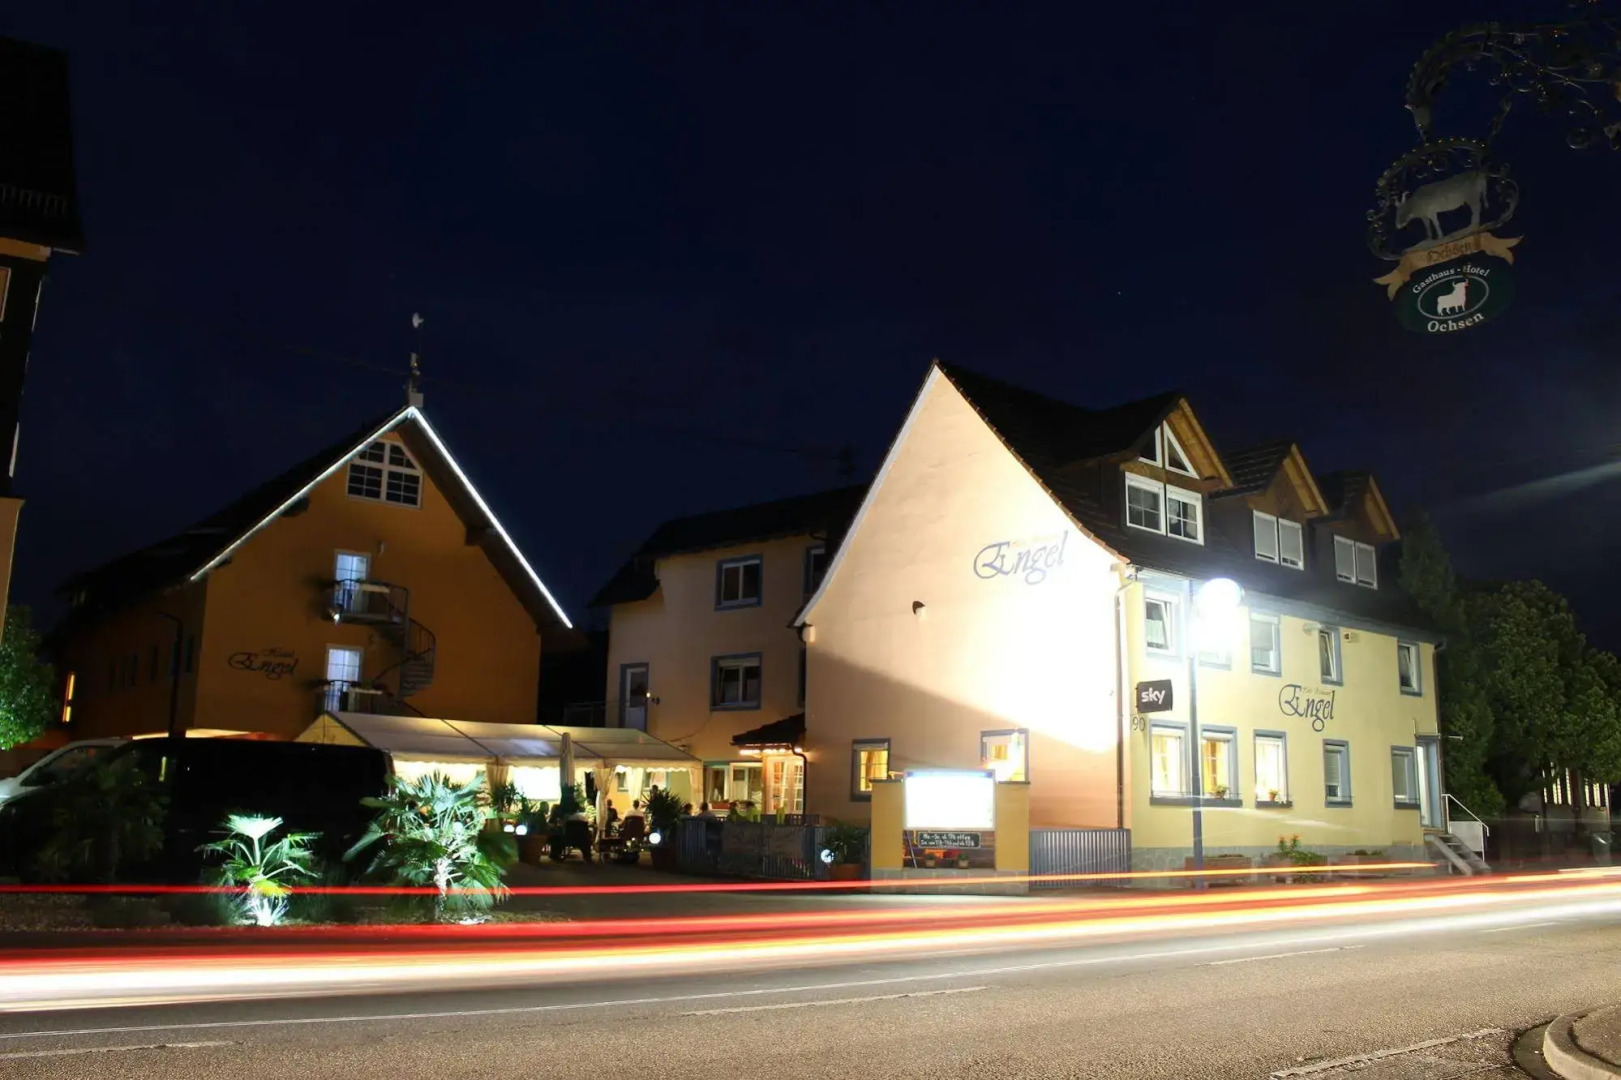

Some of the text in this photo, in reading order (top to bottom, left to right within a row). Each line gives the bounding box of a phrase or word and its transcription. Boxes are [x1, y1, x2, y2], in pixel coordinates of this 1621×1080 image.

[1412, 268, 1455, 293] Gasthaus
[1462, 264, 1490, 277] Hotel
[1427, 313, 1484, 332] Ochsen
[973, 530, 1069, 585] Engel
[1141, 687, 1165, 705] sky
[1278, 684, 1336, 732] Engel
[1132, 716, 1146, 731] 90
